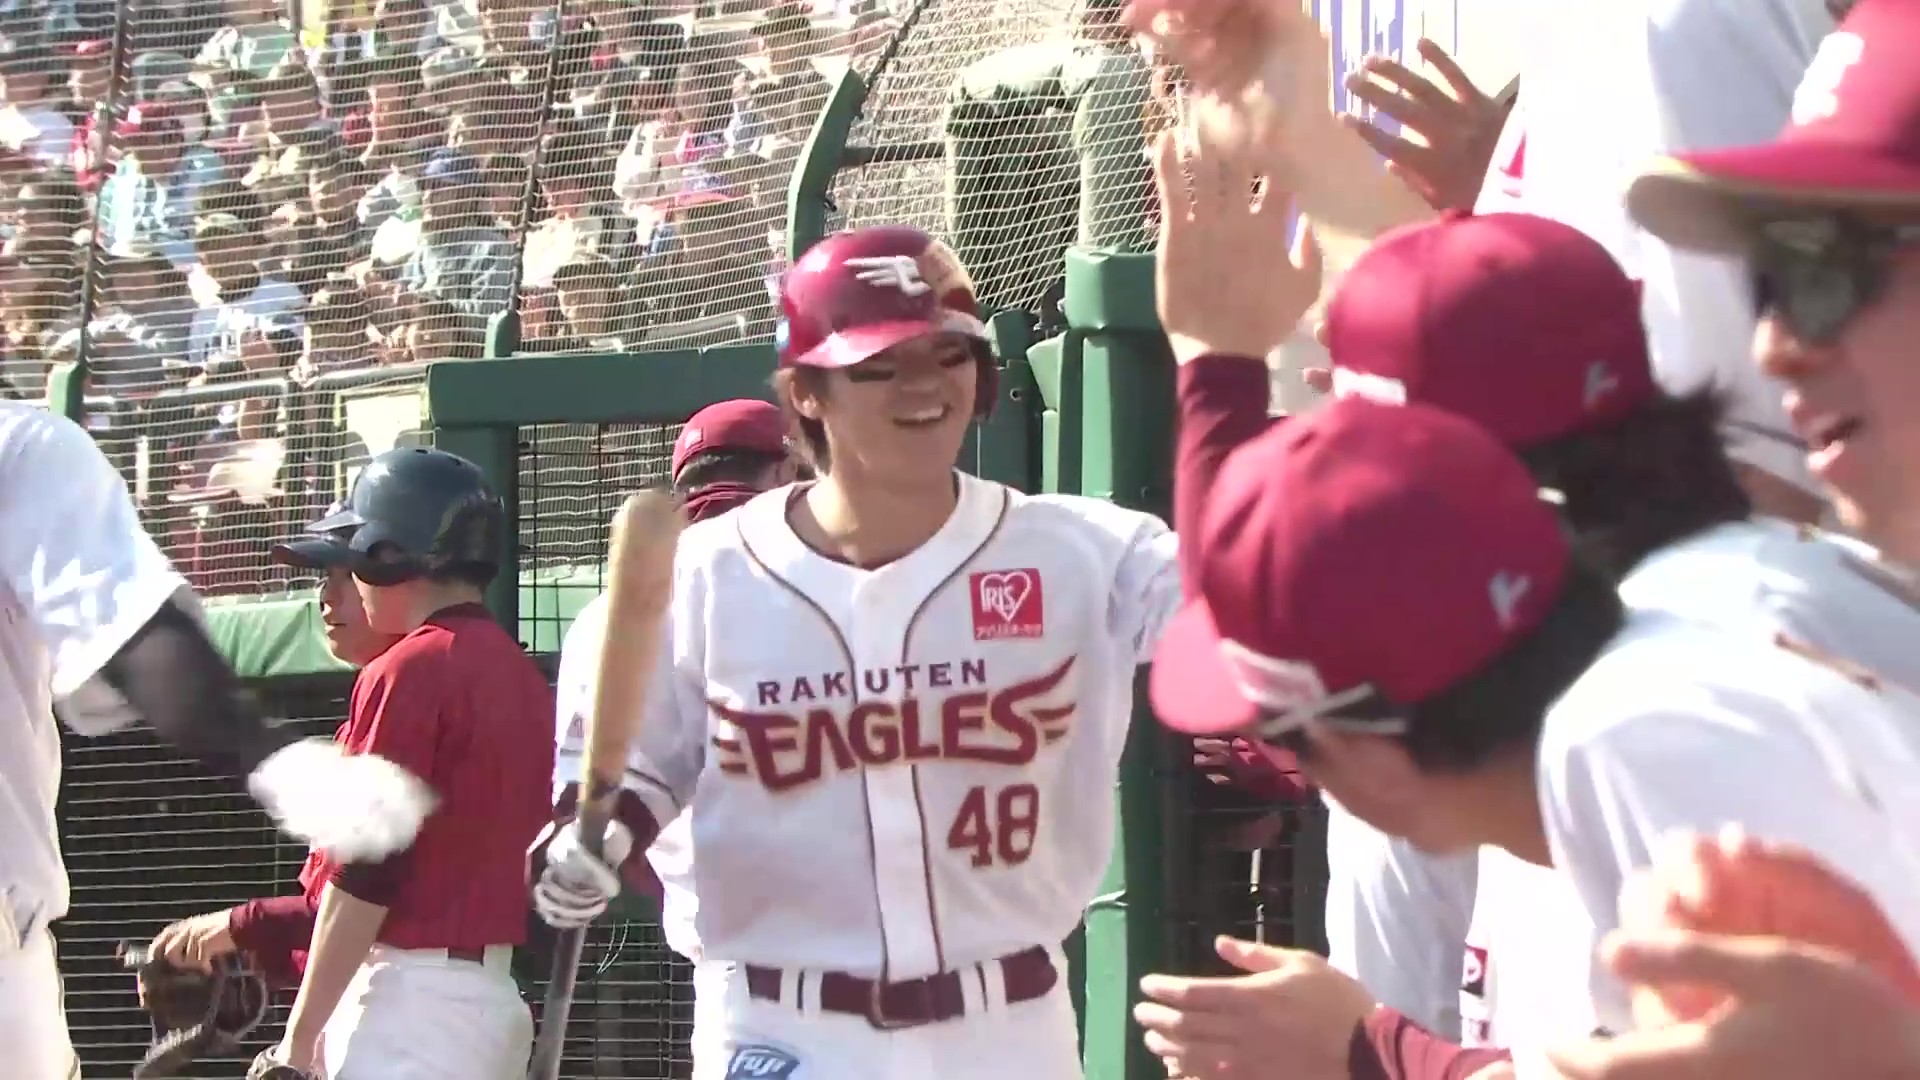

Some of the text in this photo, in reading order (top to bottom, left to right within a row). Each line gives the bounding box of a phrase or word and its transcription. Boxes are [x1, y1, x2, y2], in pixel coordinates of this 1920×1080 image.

[757, 658, 988, 706] RAKUTEN
[722, 662, 1066, 791] EAGLES
[947, 783, 1040, 869] 48
